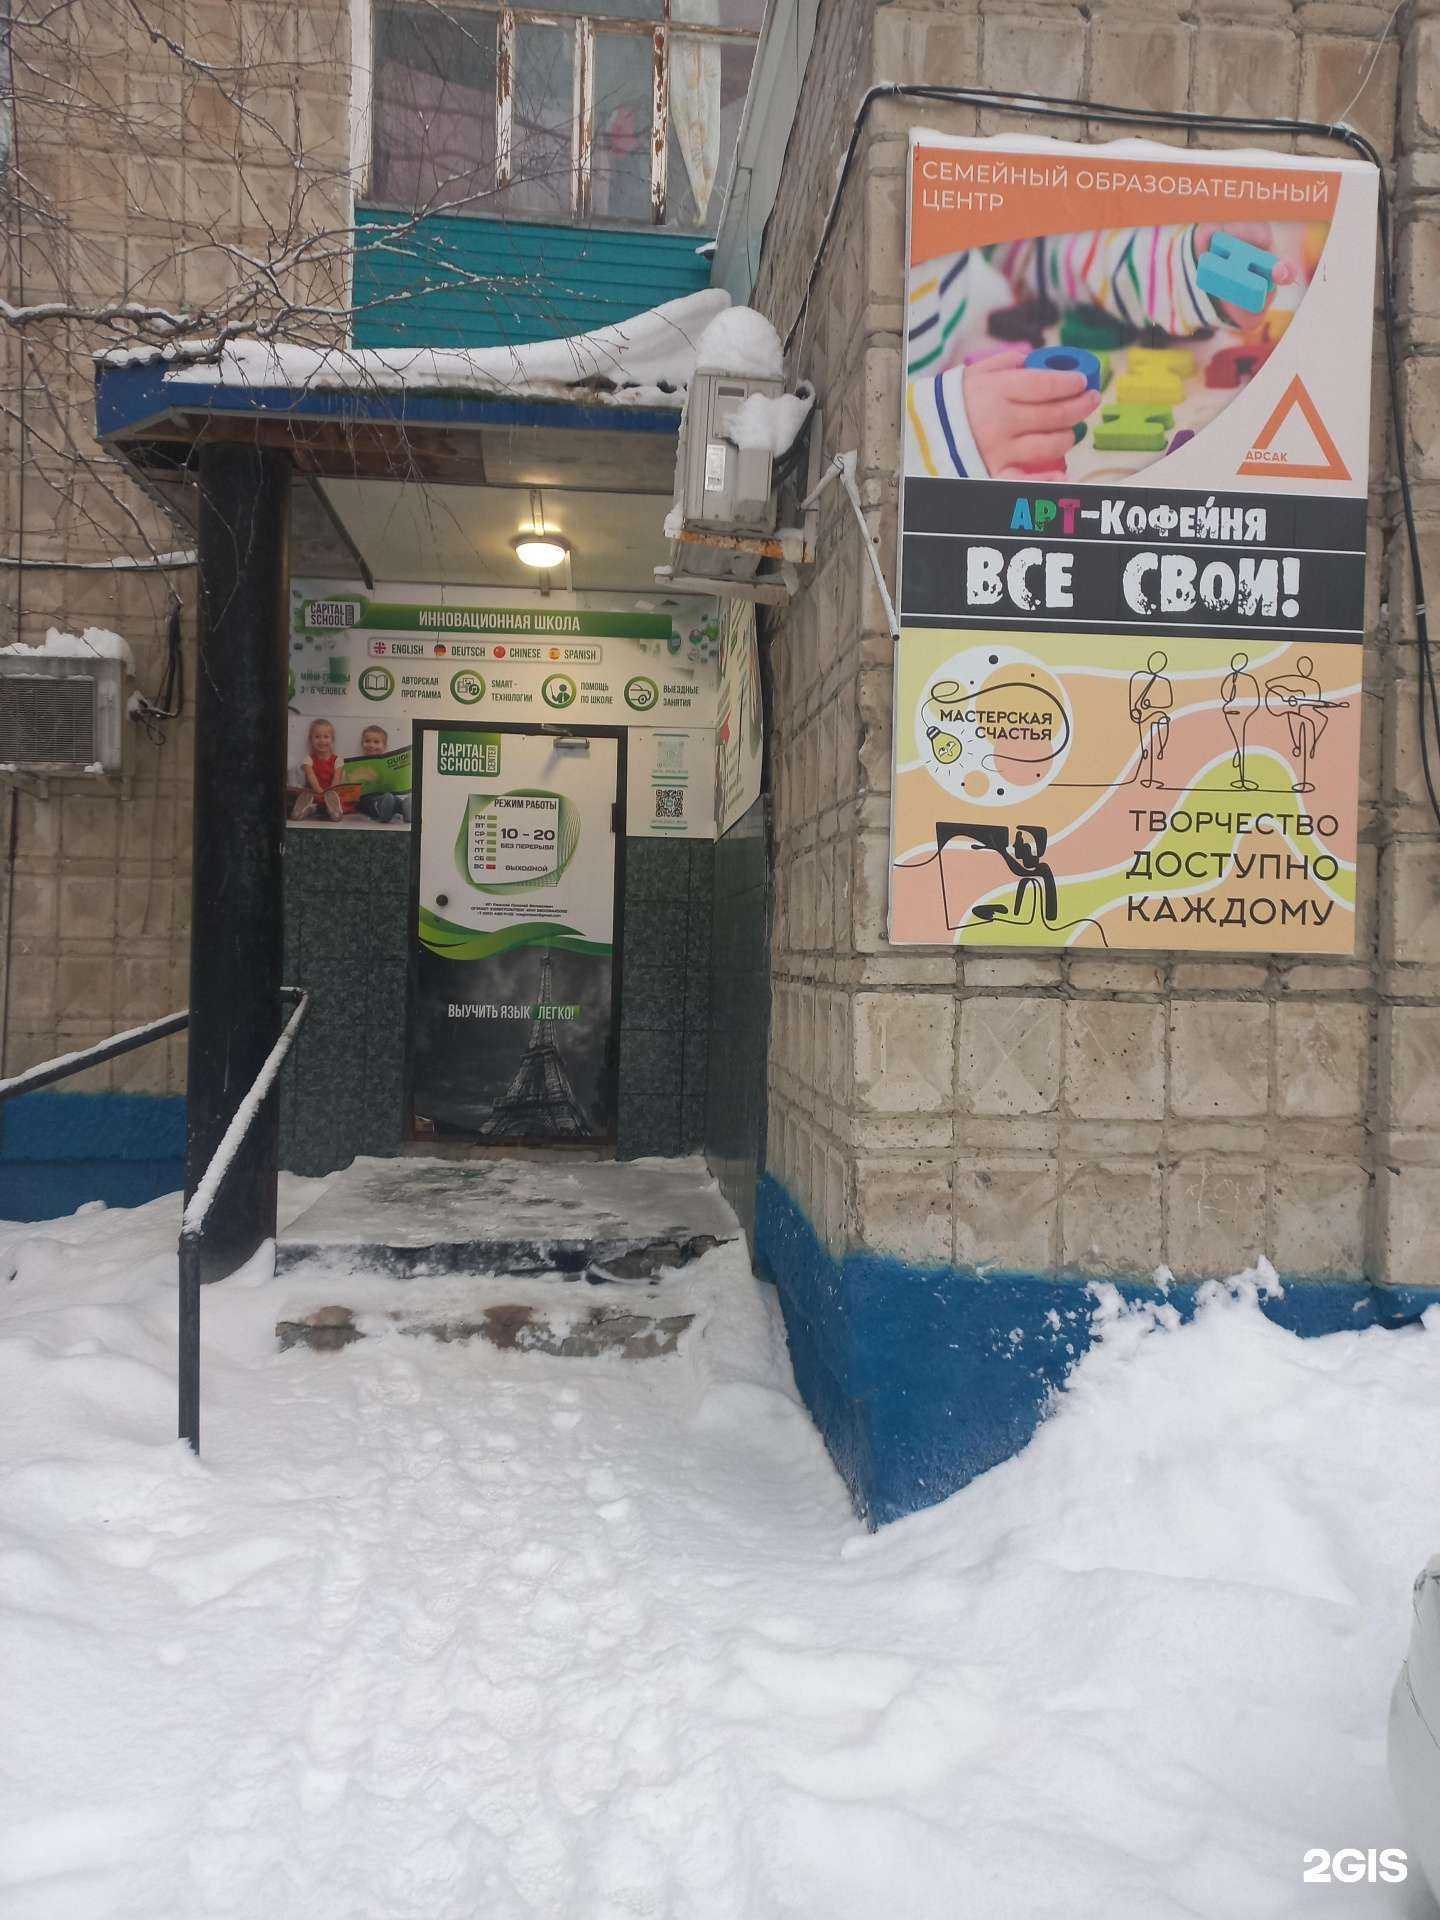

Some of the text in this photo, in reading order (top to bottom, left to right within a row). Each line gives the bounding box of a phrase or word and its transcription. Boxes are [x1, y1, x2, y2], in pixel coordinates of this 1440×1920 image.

[921, 161, 1329, 204] СЕМЕЙНЫЙ ОБРАЗОВАТЕЛЬНЫЙ
[921, 190, 1005, 213] ЦЕНТР
[1244, 448, 1289, 463] АРСАК
[966, 545, 1302, 619] ВСЕ СВОИ!
[311, 603, 345, 616] CAPITAL
[311, 614, 344, 626] SCHOOL
[418, 609, 581, 631] ИННОВАЦИОННАЯ ШКОЛА
[391, 643, 425, 655] ENGLISH
[451, 646, 486, 657] DEUTSCH
[509, 647, 542, 658] CHINESE
[564, 649, 596, 661] SPANISH
[401, 676, 439, 686] АВТОРСКАЯ
[580, 681, 609, 691] ПОМОЩЬ
[401, 689, 442, 700] ПРОГРАММА
[663, 685, 699, 695] ВЫЕЗДНЫЕ
[492, 692, 533, 703] ТЕХНОЛОГИИ
[580, 695, 614, 705] ПО ШКОЛЕ
[663, 697, 692, 708] ЗАНЯТИЯ
[939, 709, 1053, 726] МАСТЕРСКАЯ
[975, 725, 1053, 742] СЧАСТЬЯ
[440, 743, 485, 759] CAPITAL
[440, 757, 485, 772] SCHOOL
[494, 798, 557, 810] РЕЖИМ РАБОТЫ
[1128, 808, 1340, 837] ТВОРЧЕСТВО
[501, 828, 519, 840] 10
[533, 830, 556, 841] 20
[1125, 850, 1340, 882] ДОСТУПНО
[1127, 894, 1336, 929] КАЖДОМУ
[447, 1003, 577, 1021] ВЫУЧИТЬ ЯЗЫК ЛЕГКО!
